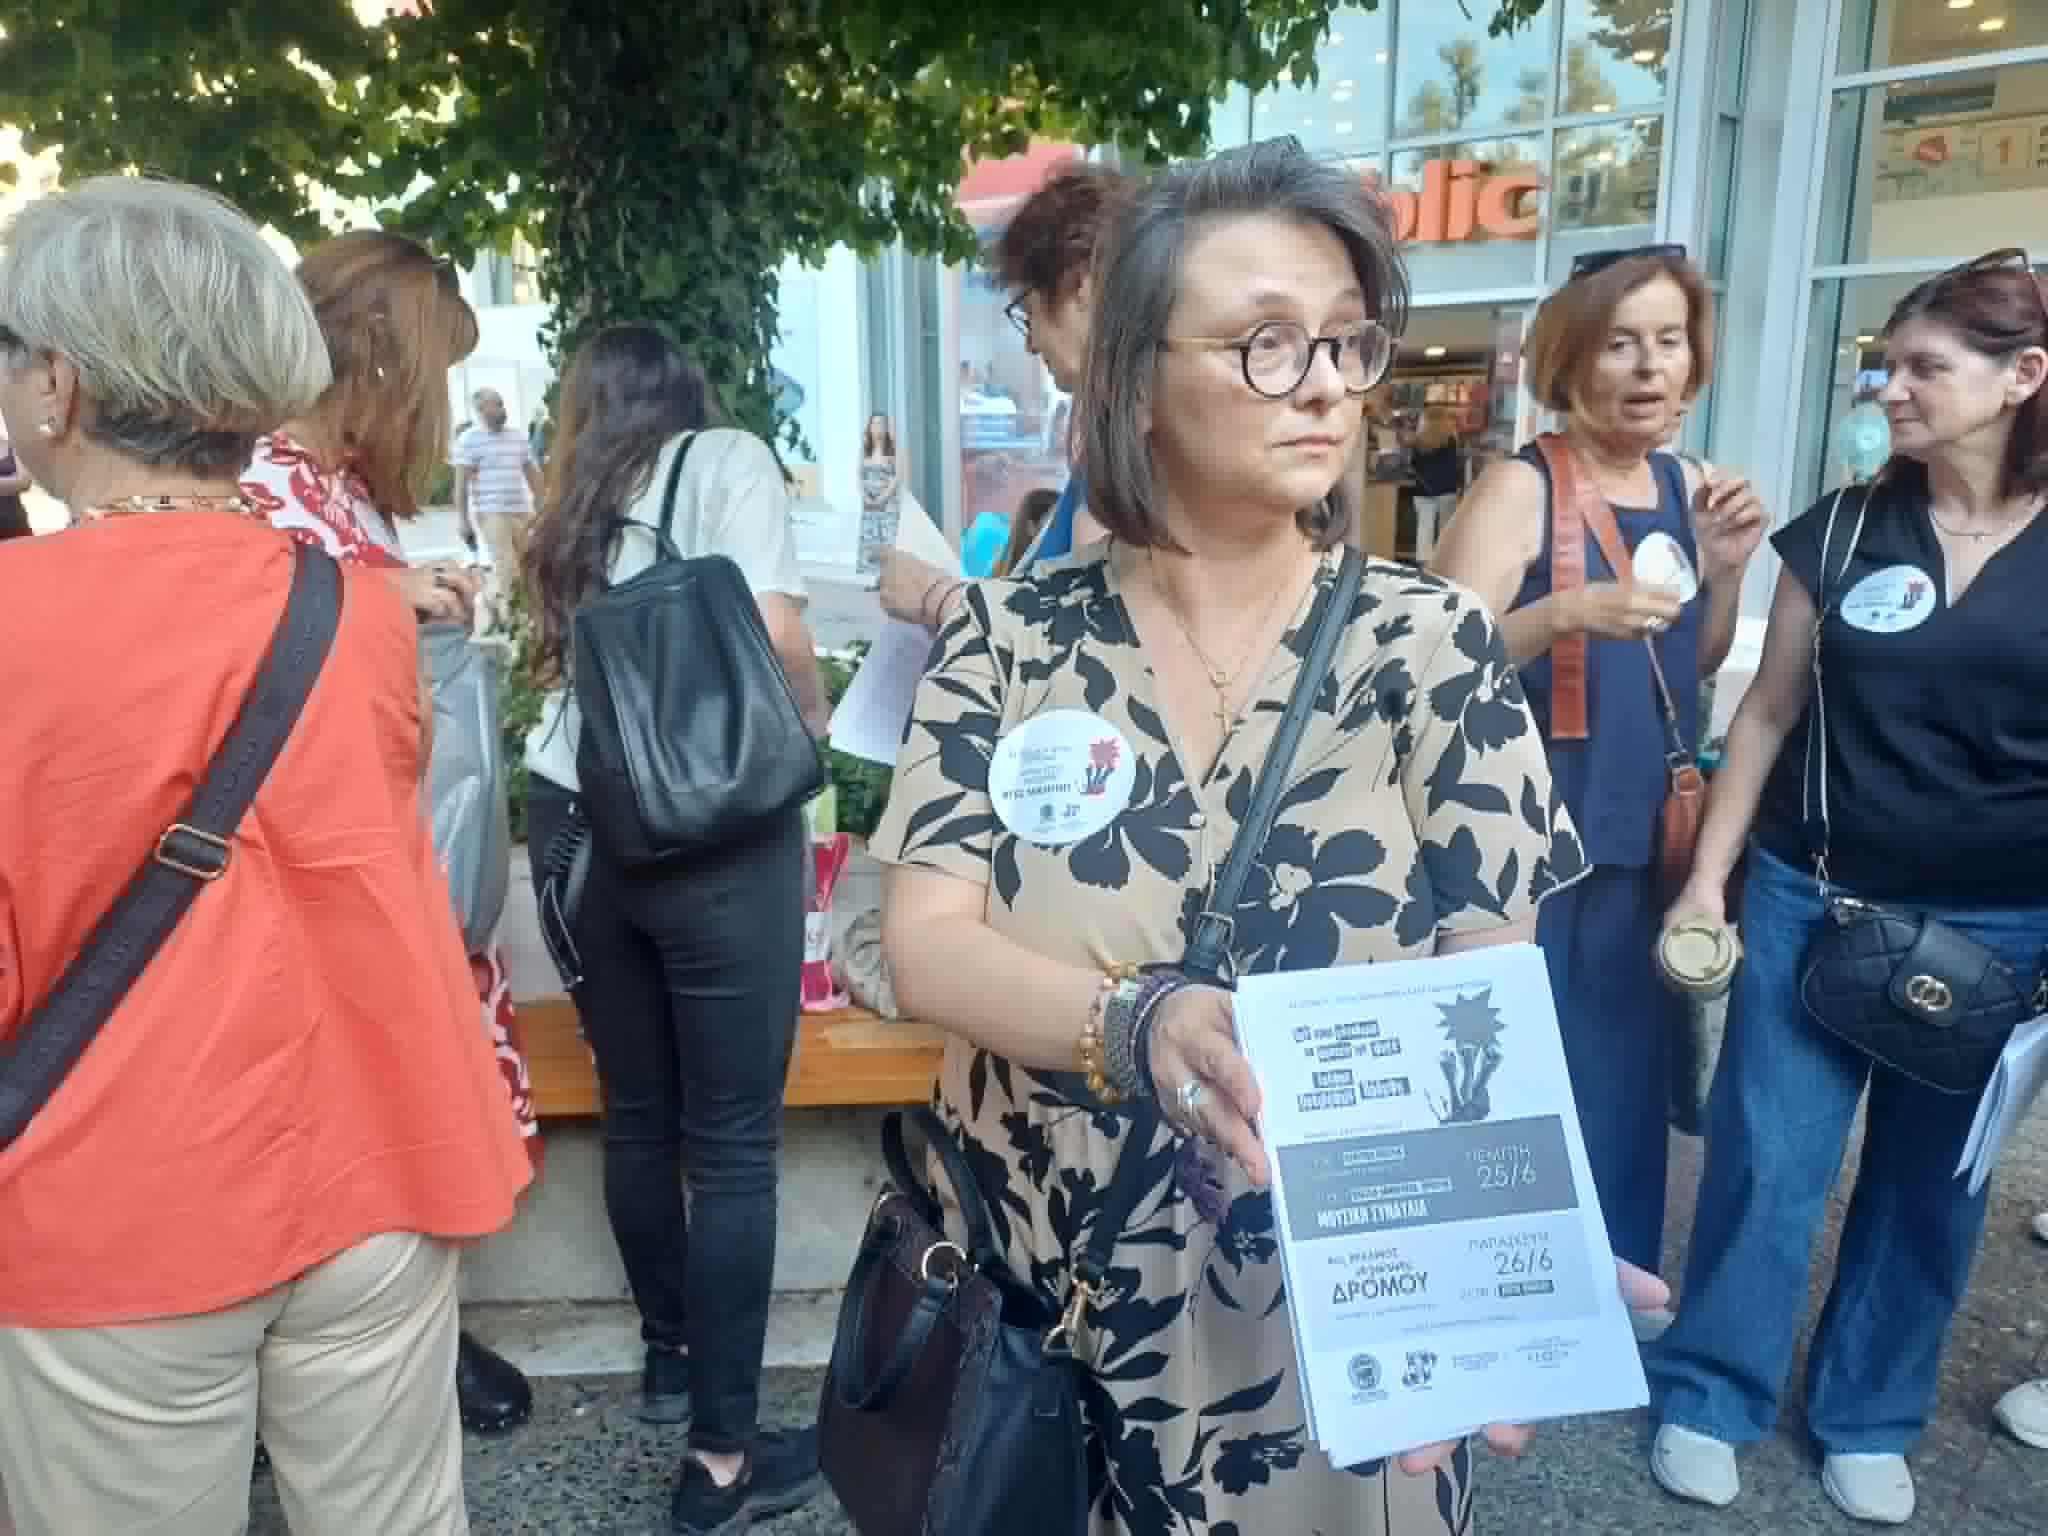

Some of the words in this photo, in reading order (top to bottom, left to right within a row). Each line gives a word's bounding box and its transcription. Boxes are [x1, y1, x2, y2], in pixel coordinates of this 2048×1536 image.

[1478, 1160, 1536, 1189] 25/6
[1494, 1248, 1553, 1275] 26/6
[1332, 1271, 1428, 1304] ΔΡΟΜΟΥ
